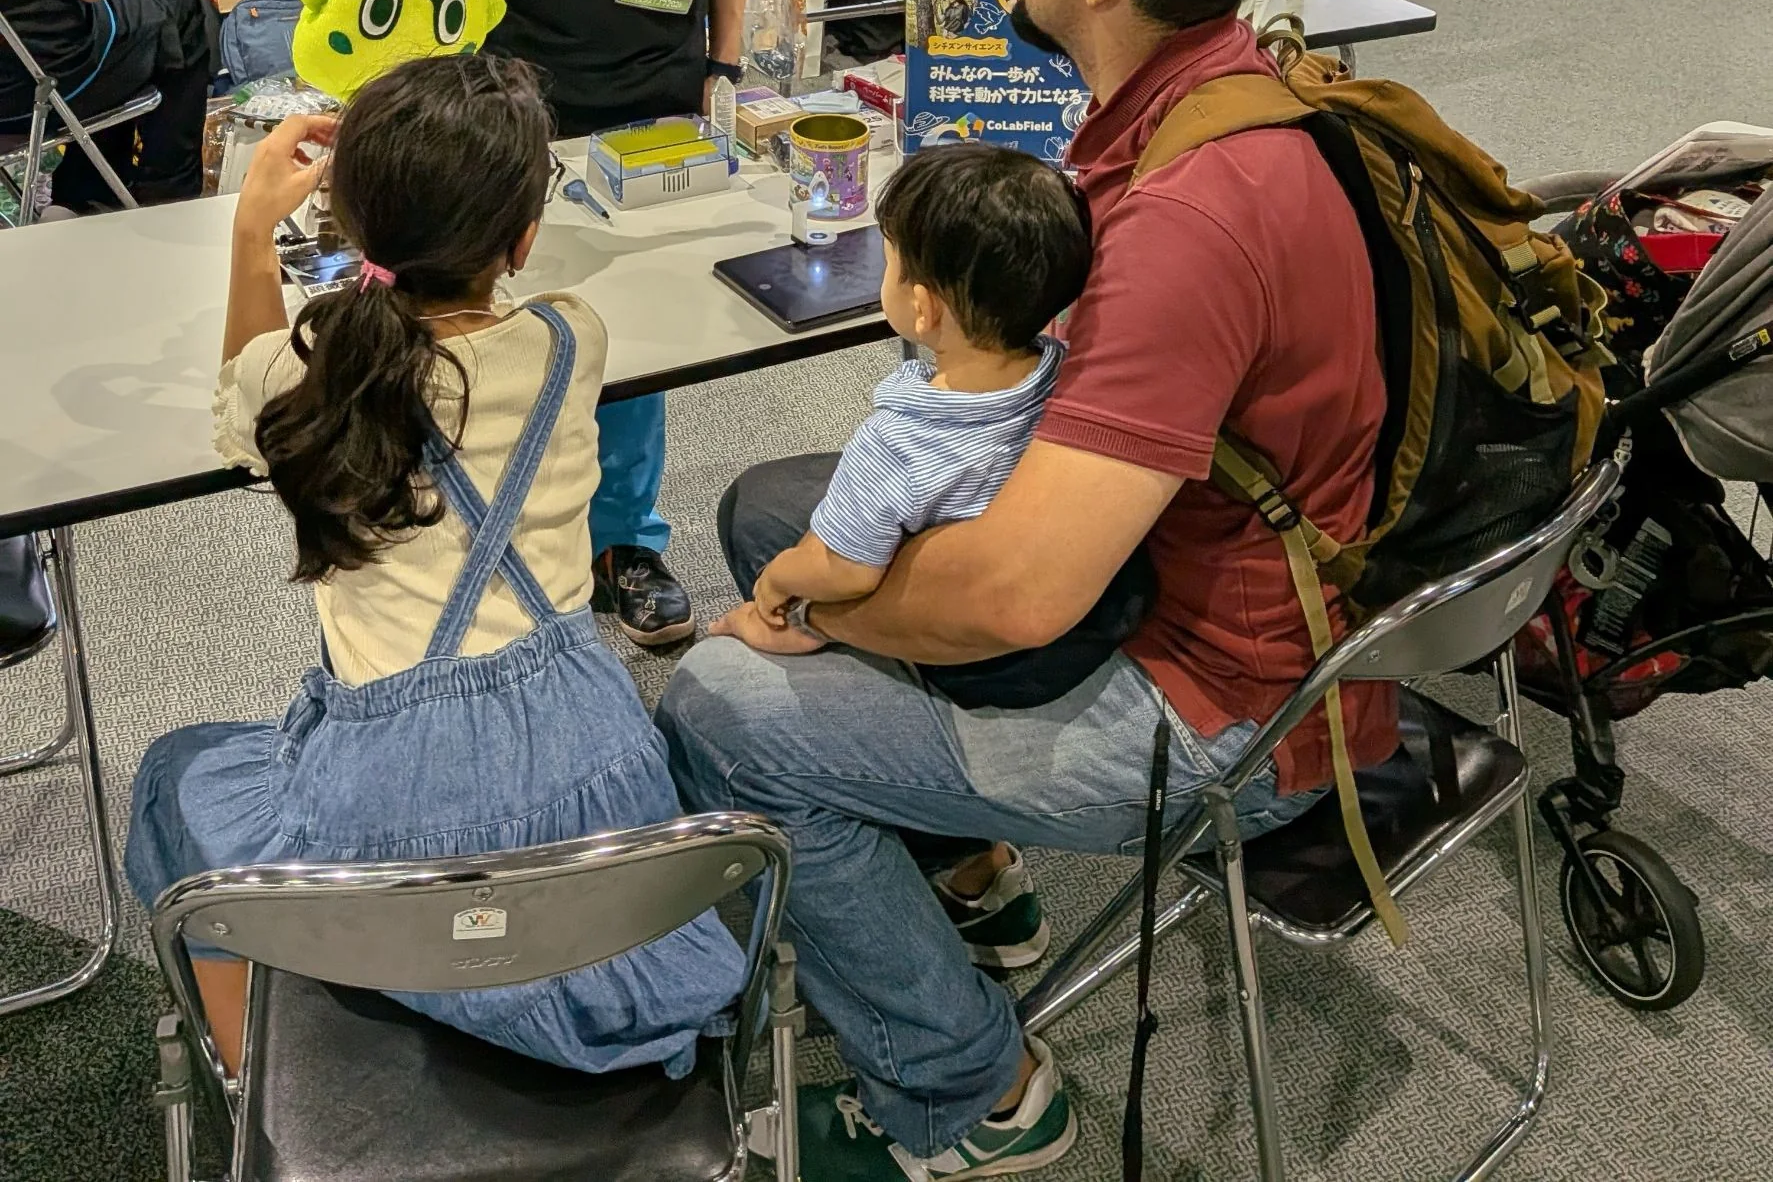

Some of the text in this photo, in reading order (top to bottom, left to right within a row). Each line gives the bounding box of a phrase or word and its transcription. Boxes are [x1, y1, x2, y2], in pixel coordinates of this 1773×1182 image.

[929, 65, 1046, 83] みんなの一歩が、
[929, 86, 1083, 105] 科学を動かす力になる
[986, 120, 1053, 132] CoLabField
